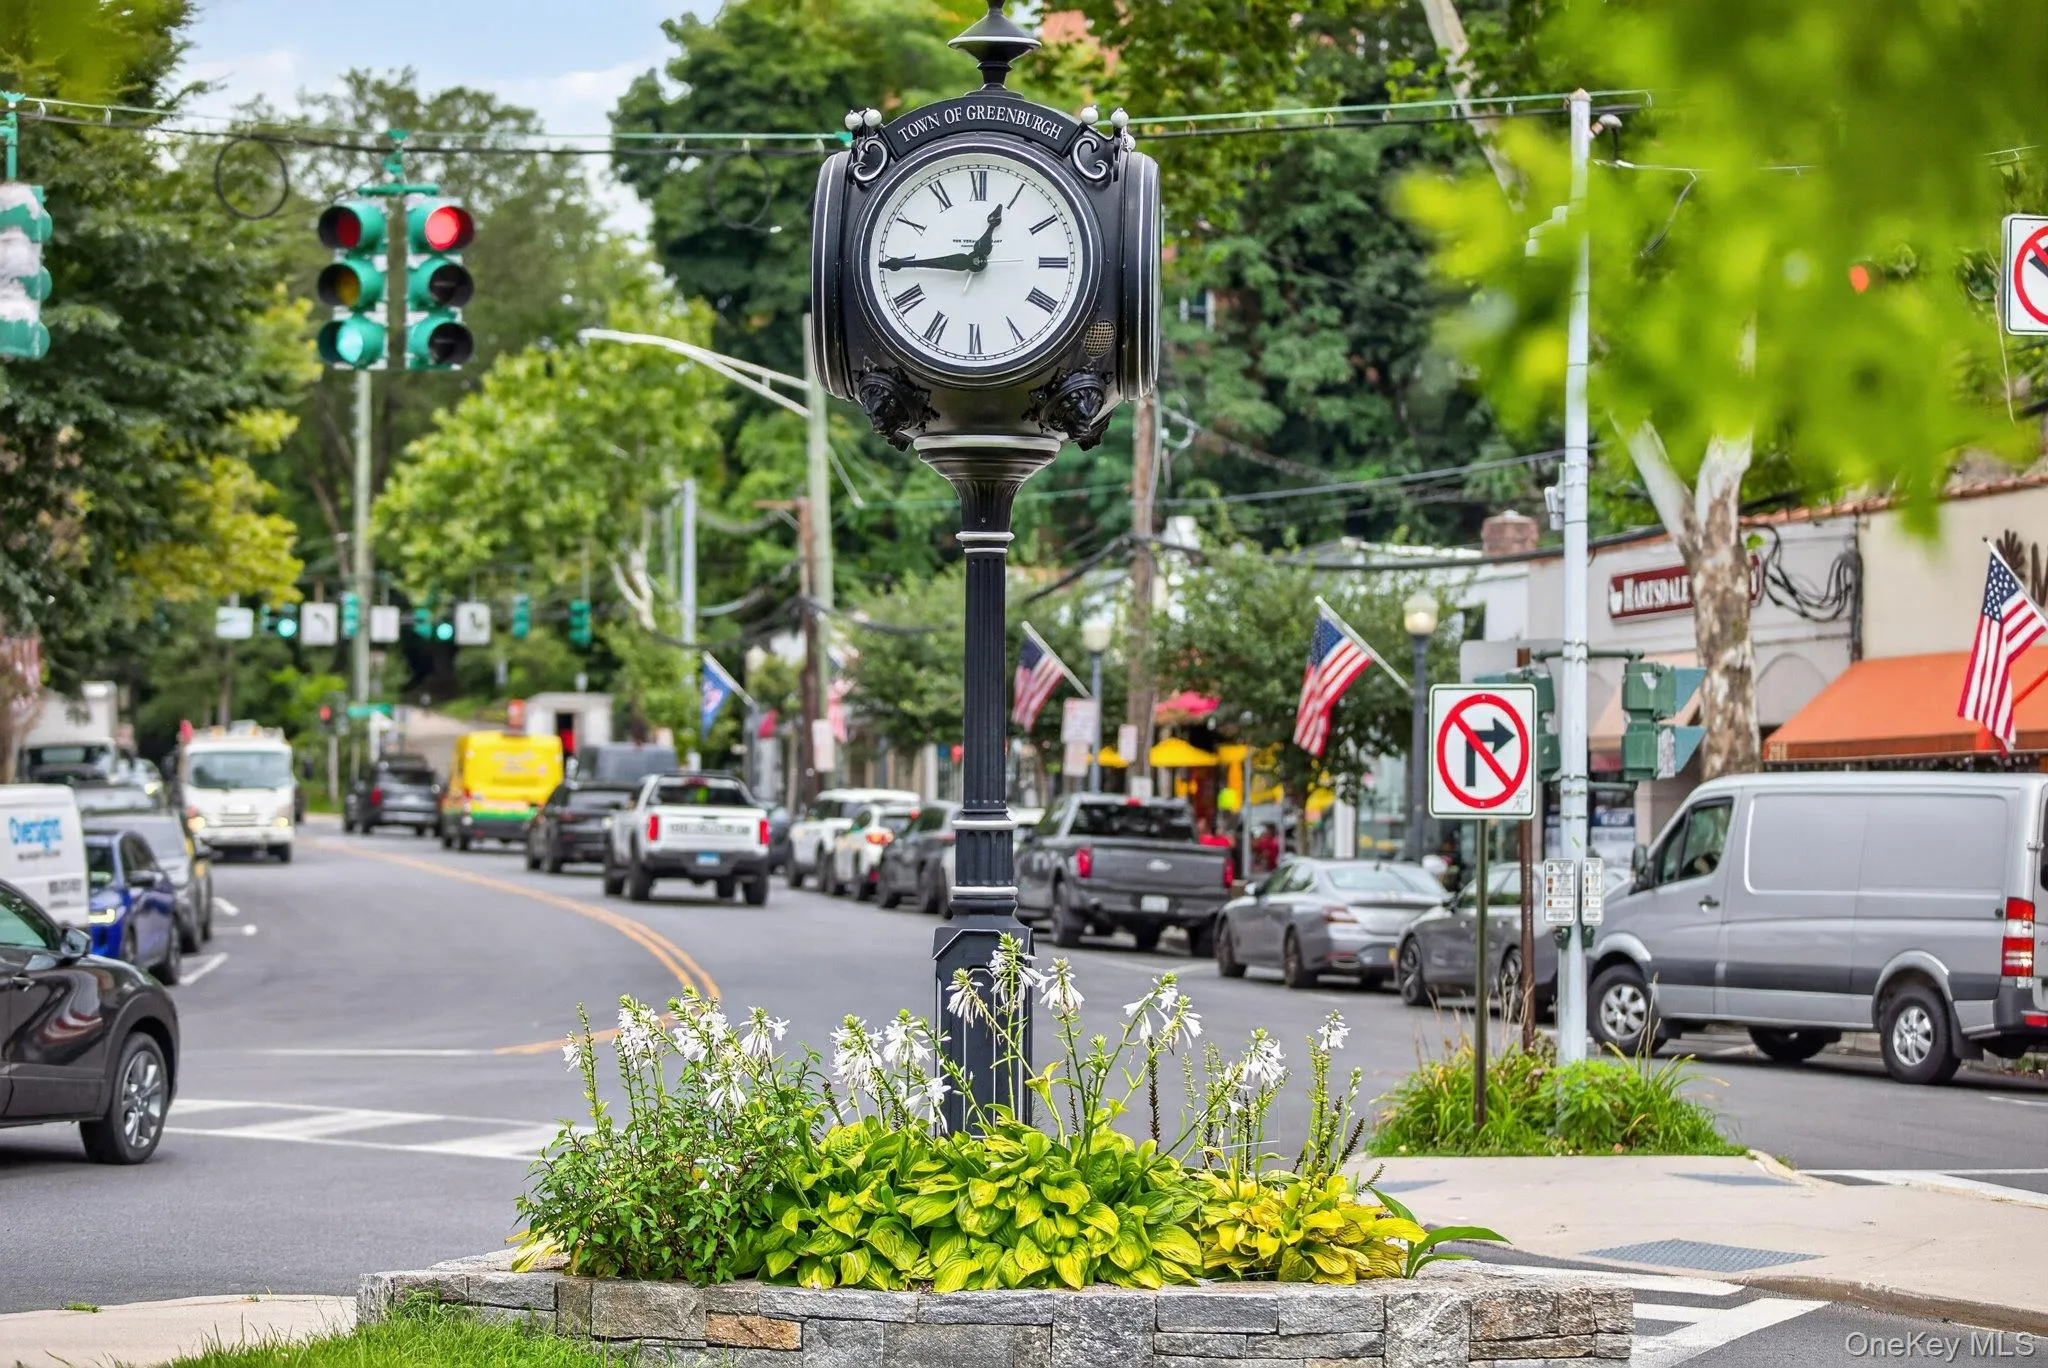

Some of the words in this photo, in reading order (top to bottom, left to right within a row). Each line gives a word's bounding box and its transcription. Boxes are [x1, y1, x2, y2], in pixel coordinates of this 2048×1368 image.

[898, 113, 941, 142] TOWN
[944, 107, 962, 124] OF
[966, 105, 1064, 140] GREENBURGH
[927, 180, 954, 214] XI
[969, 171, 988, 201] XII
[896, 212, 928, 236] X
[1029, 214, 1058, 235] II
[1038, 256, 1069, 269] III
[892, 283, 926, 317] VIII
[922, 310, 949, 346] VII
[968, 323, 984, 355] VI
[1005, 315, 1026, 345] V
